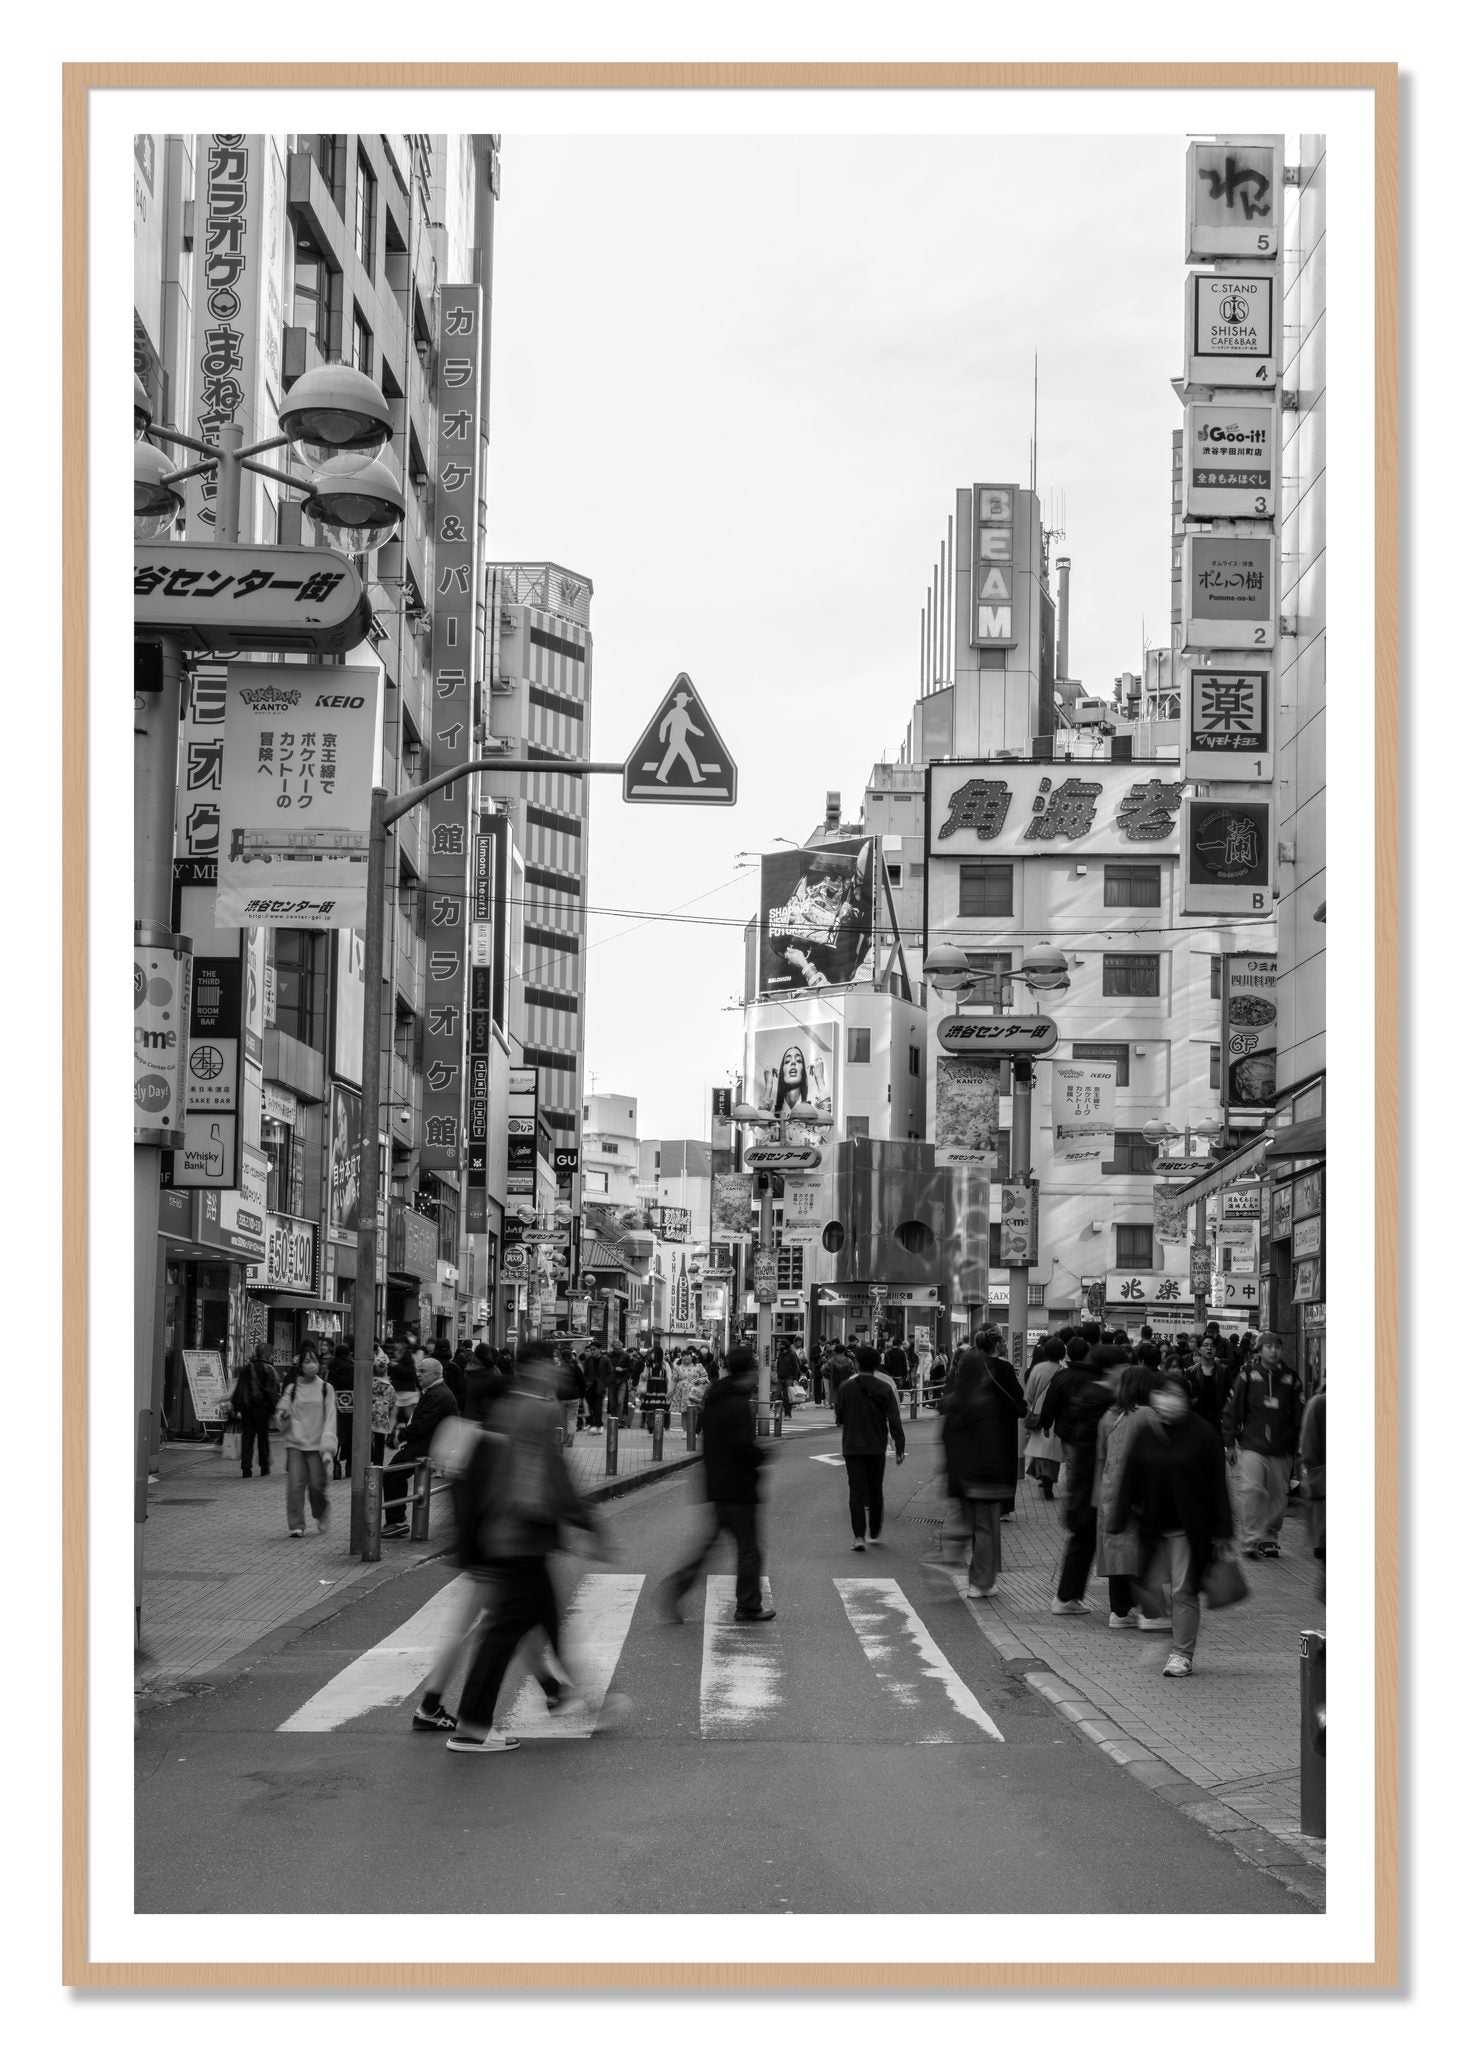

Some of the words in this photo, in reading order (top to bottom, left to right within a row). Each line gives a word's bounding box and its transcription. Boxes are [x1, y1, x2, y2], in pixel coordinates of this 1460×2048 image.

[205, 147, 249, 288] カラオケ
[1256, 234, 1270, 251] 5
[1210, 283, 1258, 294] C.STAND
[1210, 325, 1257, 337] SHISHA
[1210, 337, 1257, 346] CAFE&BAR
[1209, 426, 1266, 443] Goo-it!
[1202, 446, 1262, 457] 渋谷宇田川町店
[1197, 472, 1267, 485] 全身もみほぐし
[1254, 496, 1267, 514] 3
[978, 489, 1013, 640] BEAM
[134, 565, 346, 603] 谷センター街
[1254, 628, 1267, 644] 2
[252, 703, 289, 711] KANTO
[315, 694, 365, 709] KEIO
[1201, 677, 1254, 731] 薬
[1195, 733, 1259, 748] マツモトキヨシ
[257, 731, 275, 776] 冒険へ
[276, 731, 295, 809] カントーの
[298, 731, 317, 809] ポケパーク
[319, 732, 338, 795] 京王線で
[1253, 760, 1263, 776] 1
[1196, 817, 1259, 868] 一蘭
[479, 839, 489, 876] kimono
[244, 900, 337, 914] 渋谷センター街
[1252, 892, 1265, 910] B
[201, 970, 217, 978] THE
[196, 1007, 220, 1015] ROOM
[200, 1018, 216, 1026] BAR
[944, 1025, 1051, 1039] 渋谷センター街
[1228, 1034, 1259, 1055] 6F
[185, 1151, 220, 1162] Whisky
[556, 1154, 577, 1166] GU
[747, 1151, 813, 1162] 渋谷センター街
[184, 1161, 205, 1170] Bank
[1120, 1278, 1182, 1301] 兆楽
[680, 1276, 688, 1321] BEER
